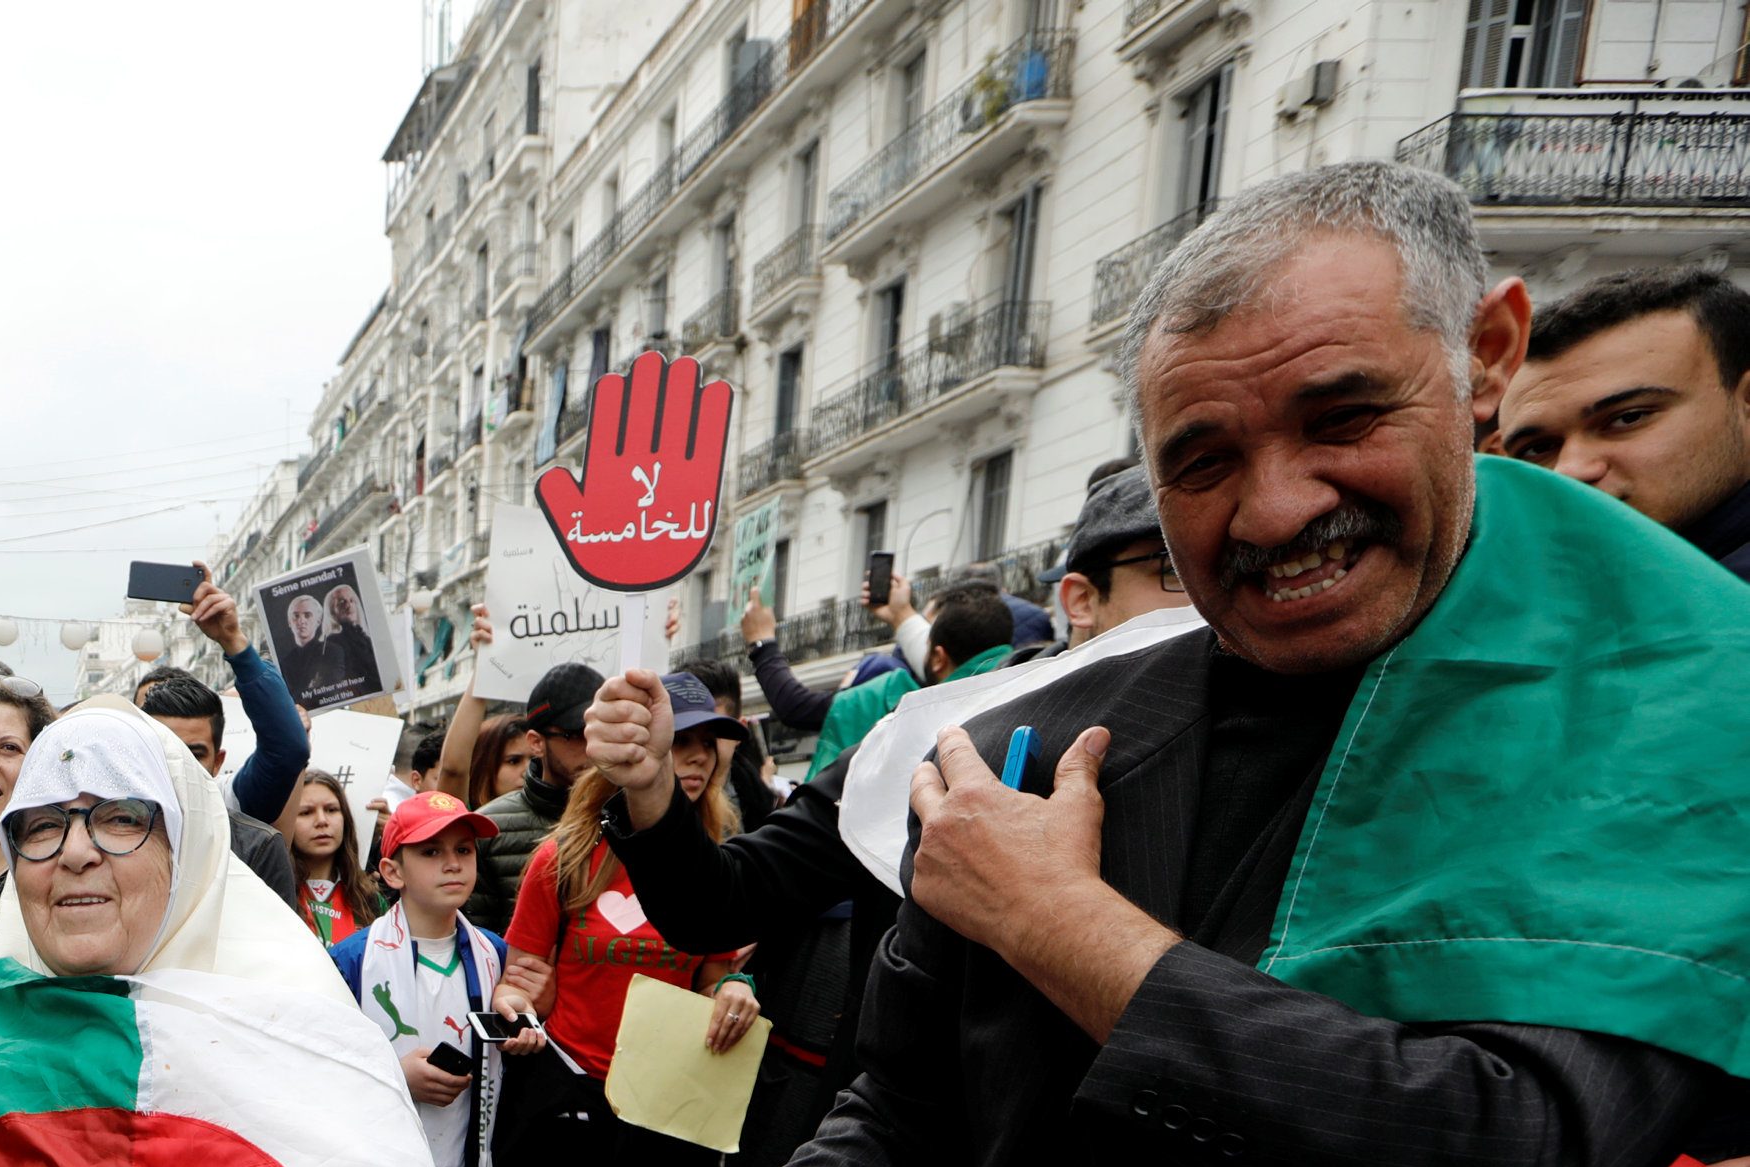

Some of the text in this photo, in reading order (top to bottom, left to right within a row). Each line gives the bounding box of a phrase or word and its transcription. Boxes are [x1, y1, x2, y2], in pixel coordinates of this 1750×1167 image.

[631, 461, 662, 507] لا
[566, 500, 712, 544] للخامسة
[272, 582, 299, 597] 5ème
[300, 569, 337, 588] mandat
[301, 676, 365, 700] My father will hear
[319, 690, 354, 705] about this
